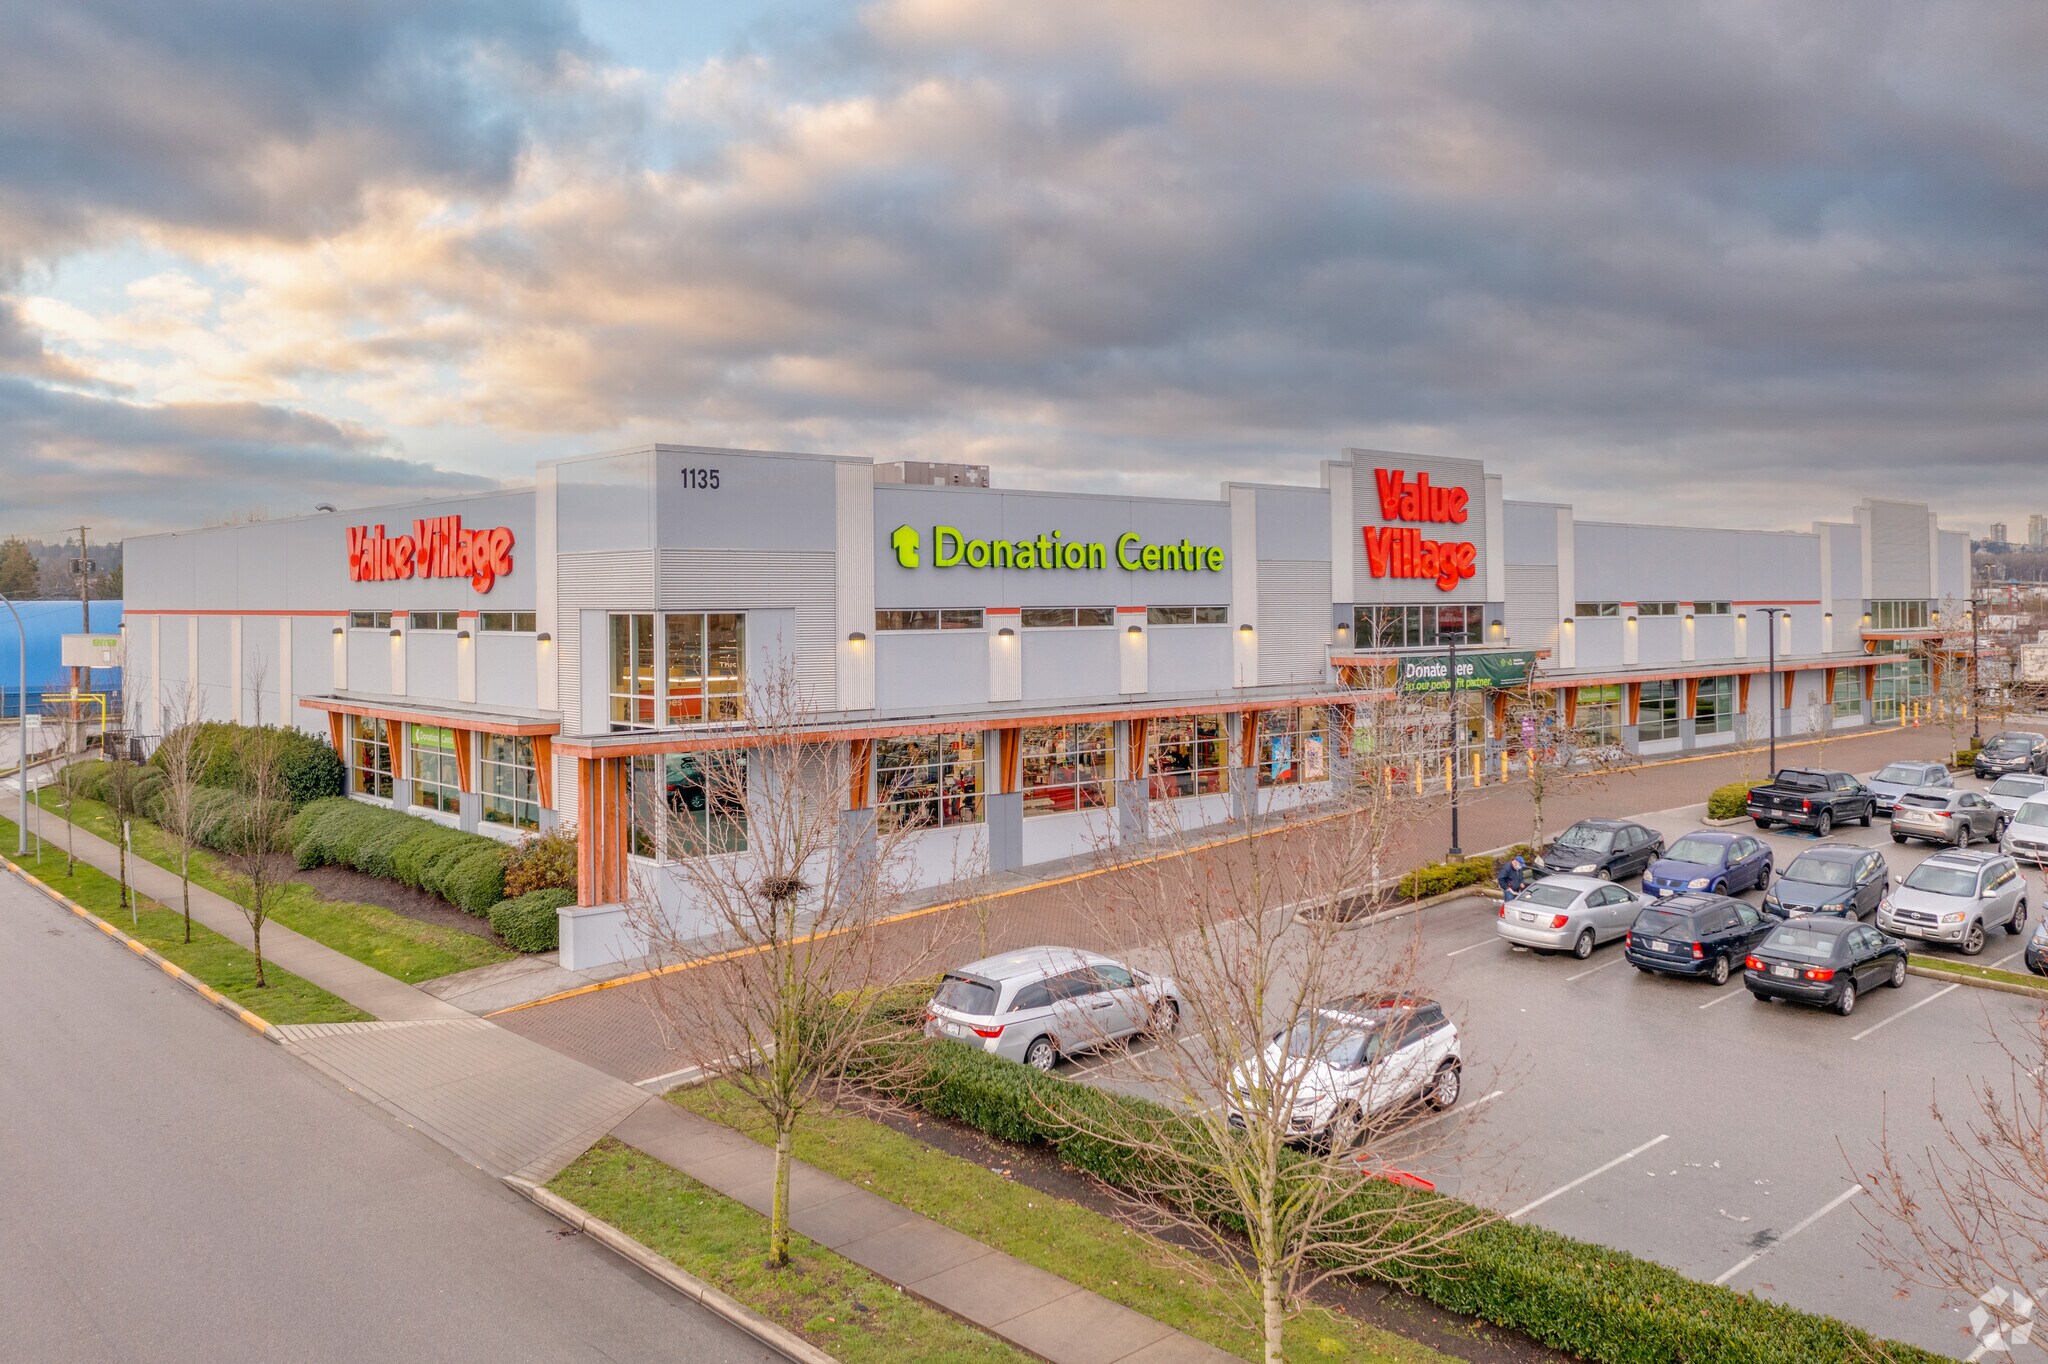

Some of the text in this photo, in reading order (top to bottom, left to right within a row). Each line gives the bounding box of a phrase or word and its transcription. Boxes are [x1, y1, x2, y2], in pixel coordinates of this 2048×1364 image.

[681, 467, 720, 490] 1135
[1374, 468, 1469, 525] Value
[346, 515, 515, 594] Value Village
[933, 525, 1225, 572] Donation Centre
[1362, 525, 1477, 593] Village
[92, 638, 117, 647] ENTER
[1406, 662, 1474, 679] Donate ere
[1416, 682, 1429, 691] our
[1431, 677, 1465, 692] nonpfit
